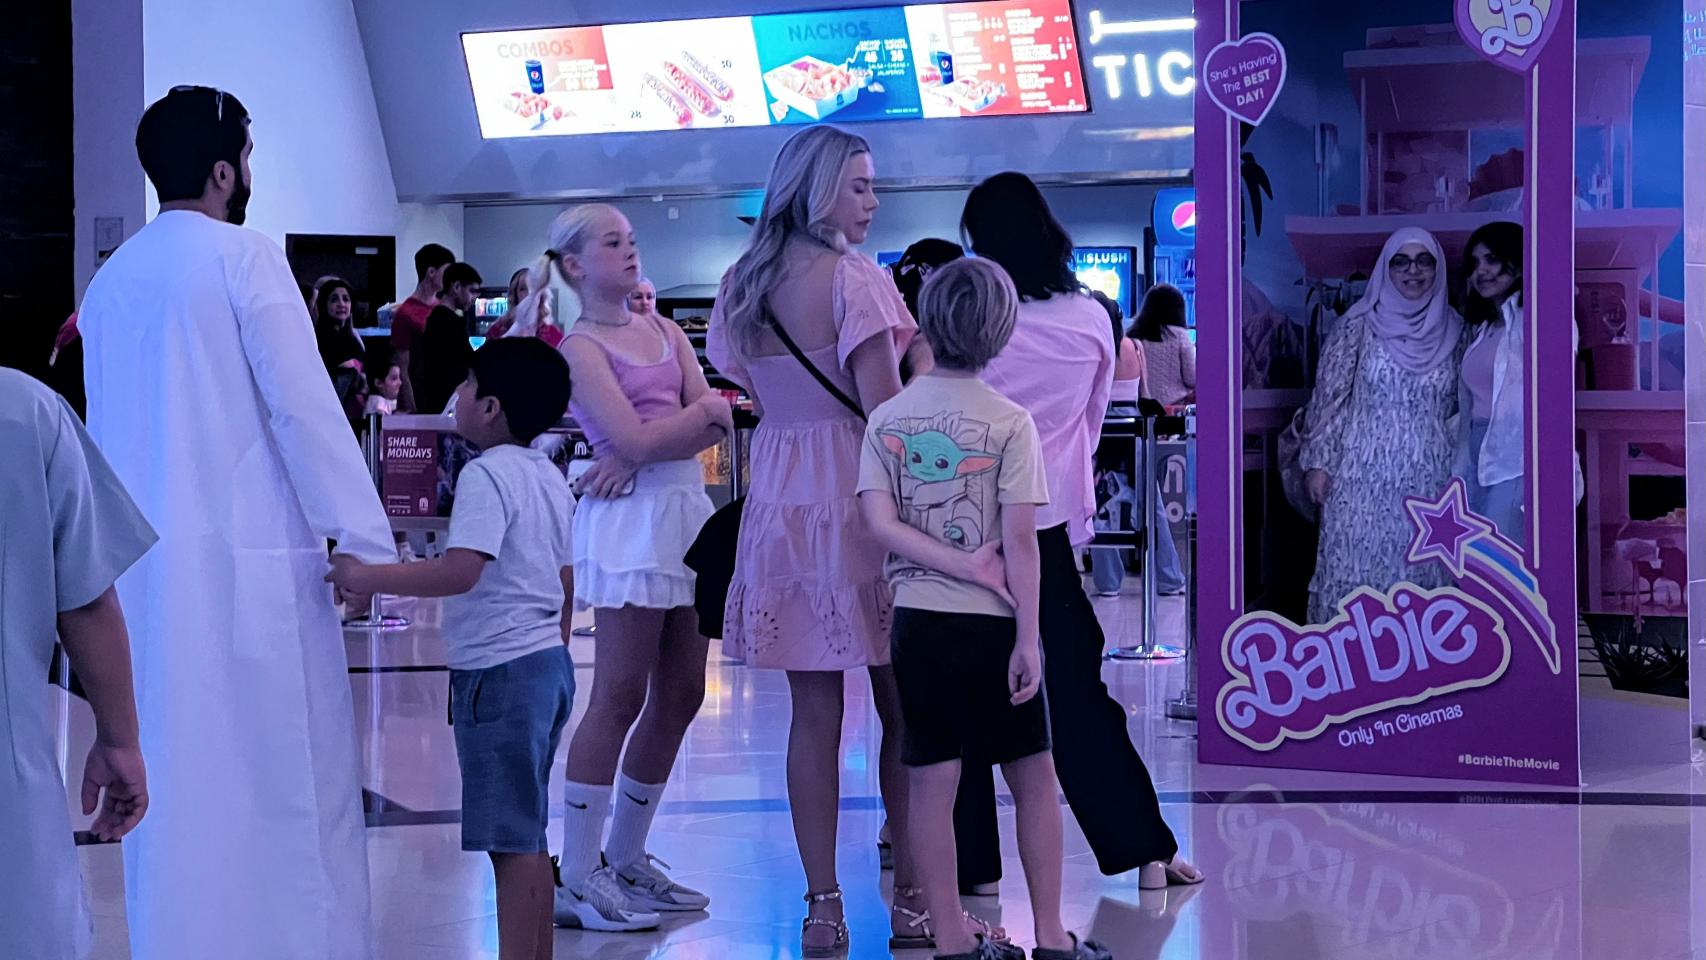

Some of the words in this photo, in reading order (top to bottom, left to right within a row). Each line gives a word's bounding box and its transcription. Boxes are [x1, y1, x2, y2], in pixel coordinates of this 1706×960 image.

[788, 21, 872, 42] NACHOS
[497, 39, 574, 58] COMBOS
[1210, 66, 1237, 82] She's
[1239, 53, 1277, 73] Having
[1222, 81, 1241, 94] The
[1243, 69, 1271, 87] BEST
[1236, 87, 1264, 106] DAY!
[722, 114, 735, 124] 30
[387, 437, 418, 447] SHARE
[386, 448, 432, 459] MONDAYS
[1225, 594, 1478, 729] Barbie
[1338, 724, 1374, 748] Only
[1375, 718, 1394, 738] In
[1395, 704, 1463, 733] Cinemas
[1458, 753, 1560, 771] #BarbieTheMovie
